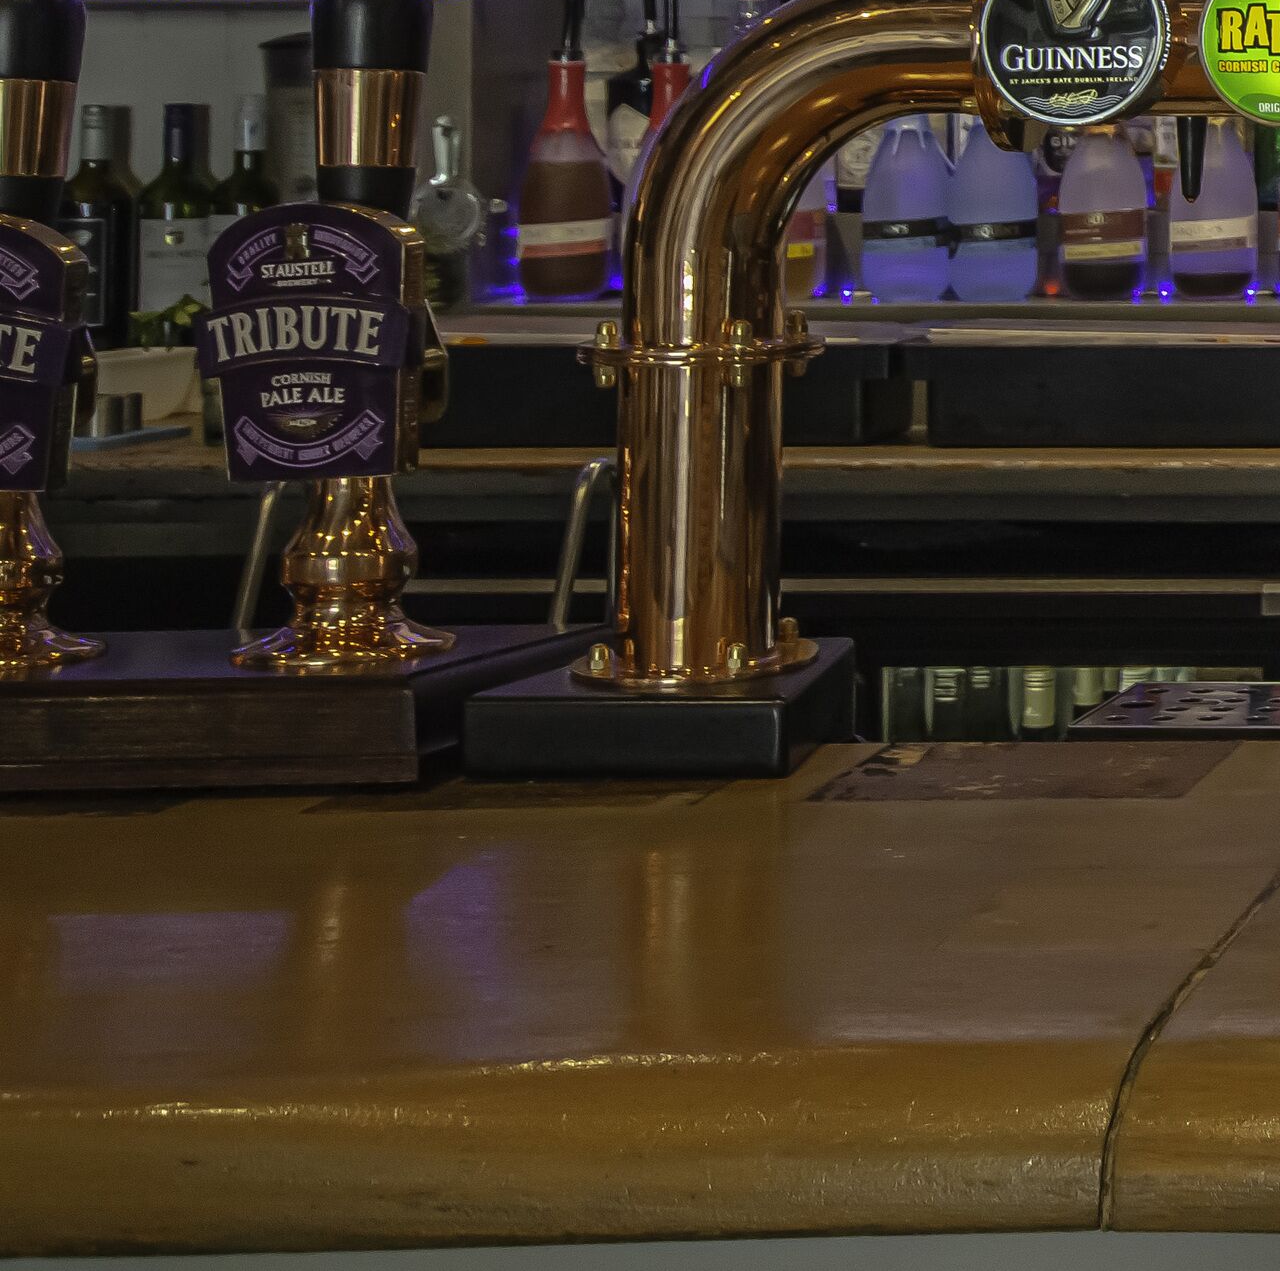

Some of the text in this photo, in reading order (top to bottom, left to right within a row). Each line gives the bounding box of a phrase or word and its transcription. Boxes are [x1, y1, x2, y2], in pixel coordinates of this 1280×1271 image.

[1002, 43, 1145, 73] GUINNESS
[1218, 59, 1268, 73] CORNISH
[1053, 77, 1072, 85] GATE
[275, 261, 337, 277] AUSTELL
[206, 305, 385, 364] TRIBUTE
[271, 371, 332, 387] CORNISH
[259, 386, 346, 408] PALE ALE
